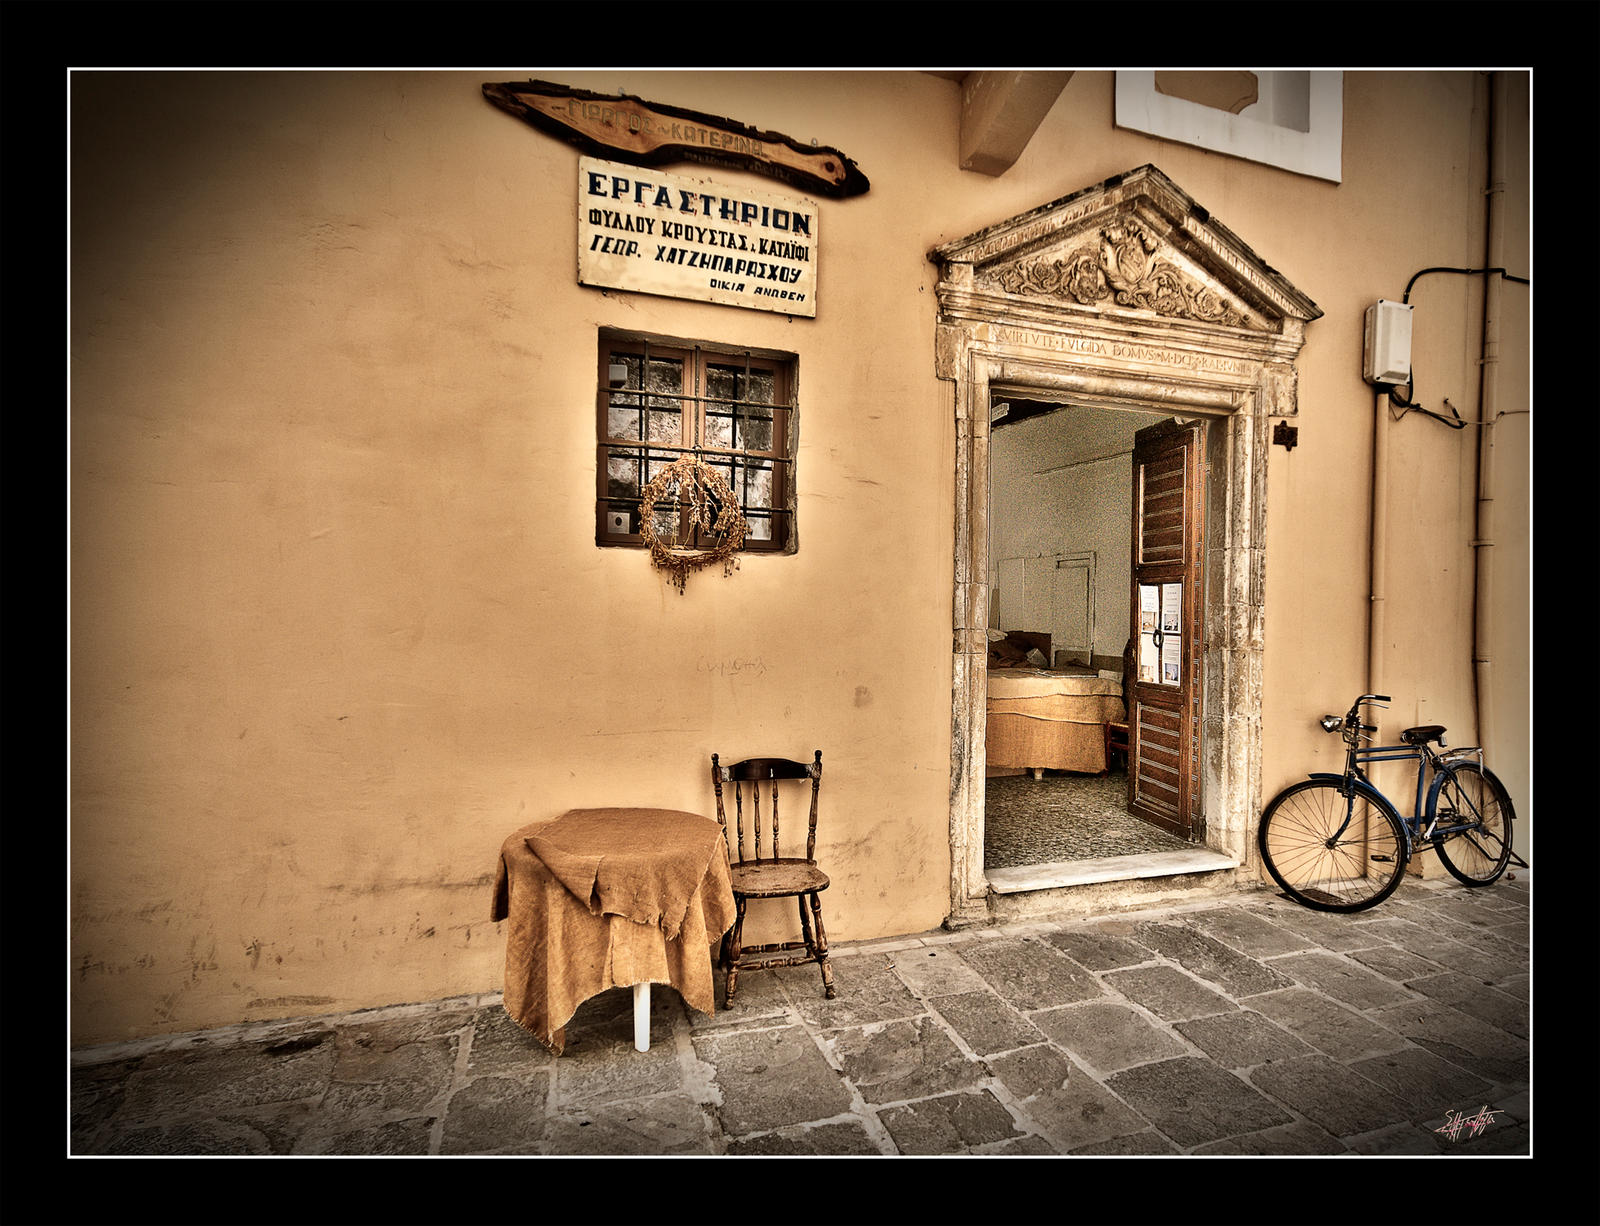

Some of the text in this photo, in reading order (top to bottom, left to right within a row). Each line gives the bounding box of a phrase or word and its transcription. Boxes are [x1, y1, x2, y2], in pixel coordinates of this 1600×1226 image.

[671, 122, 763, 156] ΚΑΤΕΡΙΝΑ
[588, 171, 812, 236] ΕΡΓΑΣΤΗΡΙΟΝ
[589, 208, 656, 235] ΦΥΛΛΟΥ
[661, 220, 749, 252] ΚΡΟΥΣΤΑΣ
[758, 237, 810, 262] ΚΑΤΑΪΦΙ
[590, 234, 803, 284] ΓΕΩΡ. ΧΑΤΖΗΠΑΡΑΣΧΟΥ
[709, 278, 745, 293] ΟΙΚΙΑ
